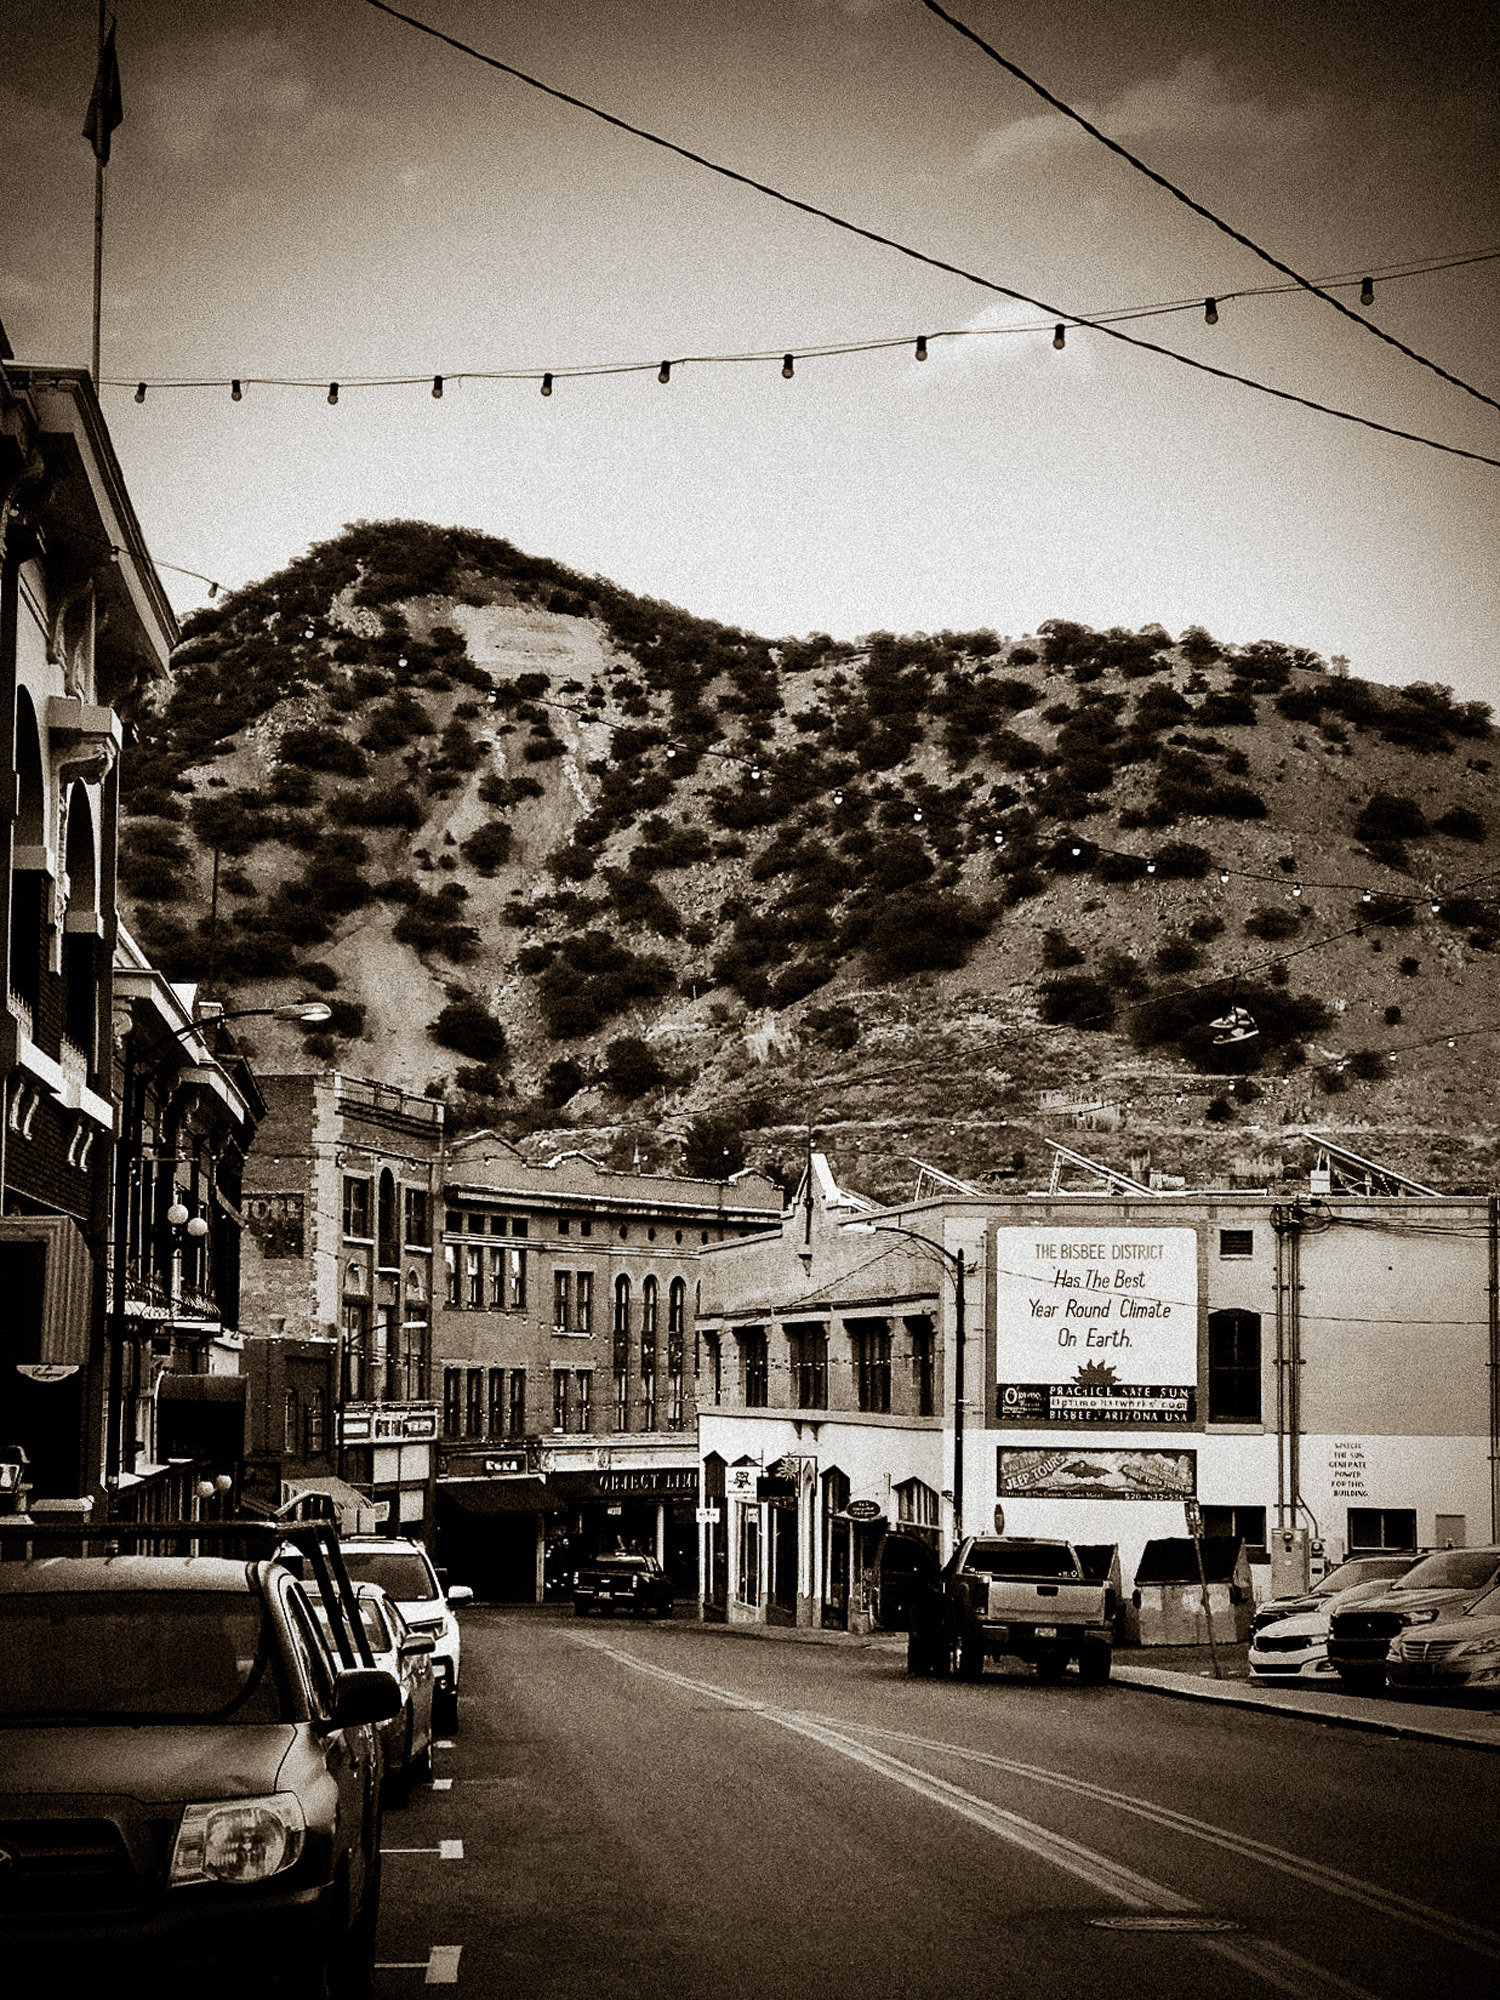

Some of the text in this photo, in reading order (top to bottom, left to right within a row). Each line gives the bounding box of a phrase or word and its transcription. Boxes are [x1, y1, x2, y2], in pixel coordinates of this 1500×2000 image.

[1035, 1243, 1164, 1260] THE BISBEE DISTRICT
[1054, 1269, 1146, 1289] Has The Best
[1029, 1299, 1171, 1318] Year Round Climate
[1058, 1328, 1133, 1348] On Earth.
[1049, 1386, 1190, 1398] PRACTICE SAFE SUN
[1104, 1411, 1158, 1422] ARIZONA
[1165, 1412, 1188, 1422] USA
[1005, 1452, 1066, 1490] JEEP TOURS
[599, 1473, 660, 1490] OBJECT
[1330, 1480, 1346, 1488] FOR
[1333, 1490, 1369, 1498] BUILDING
